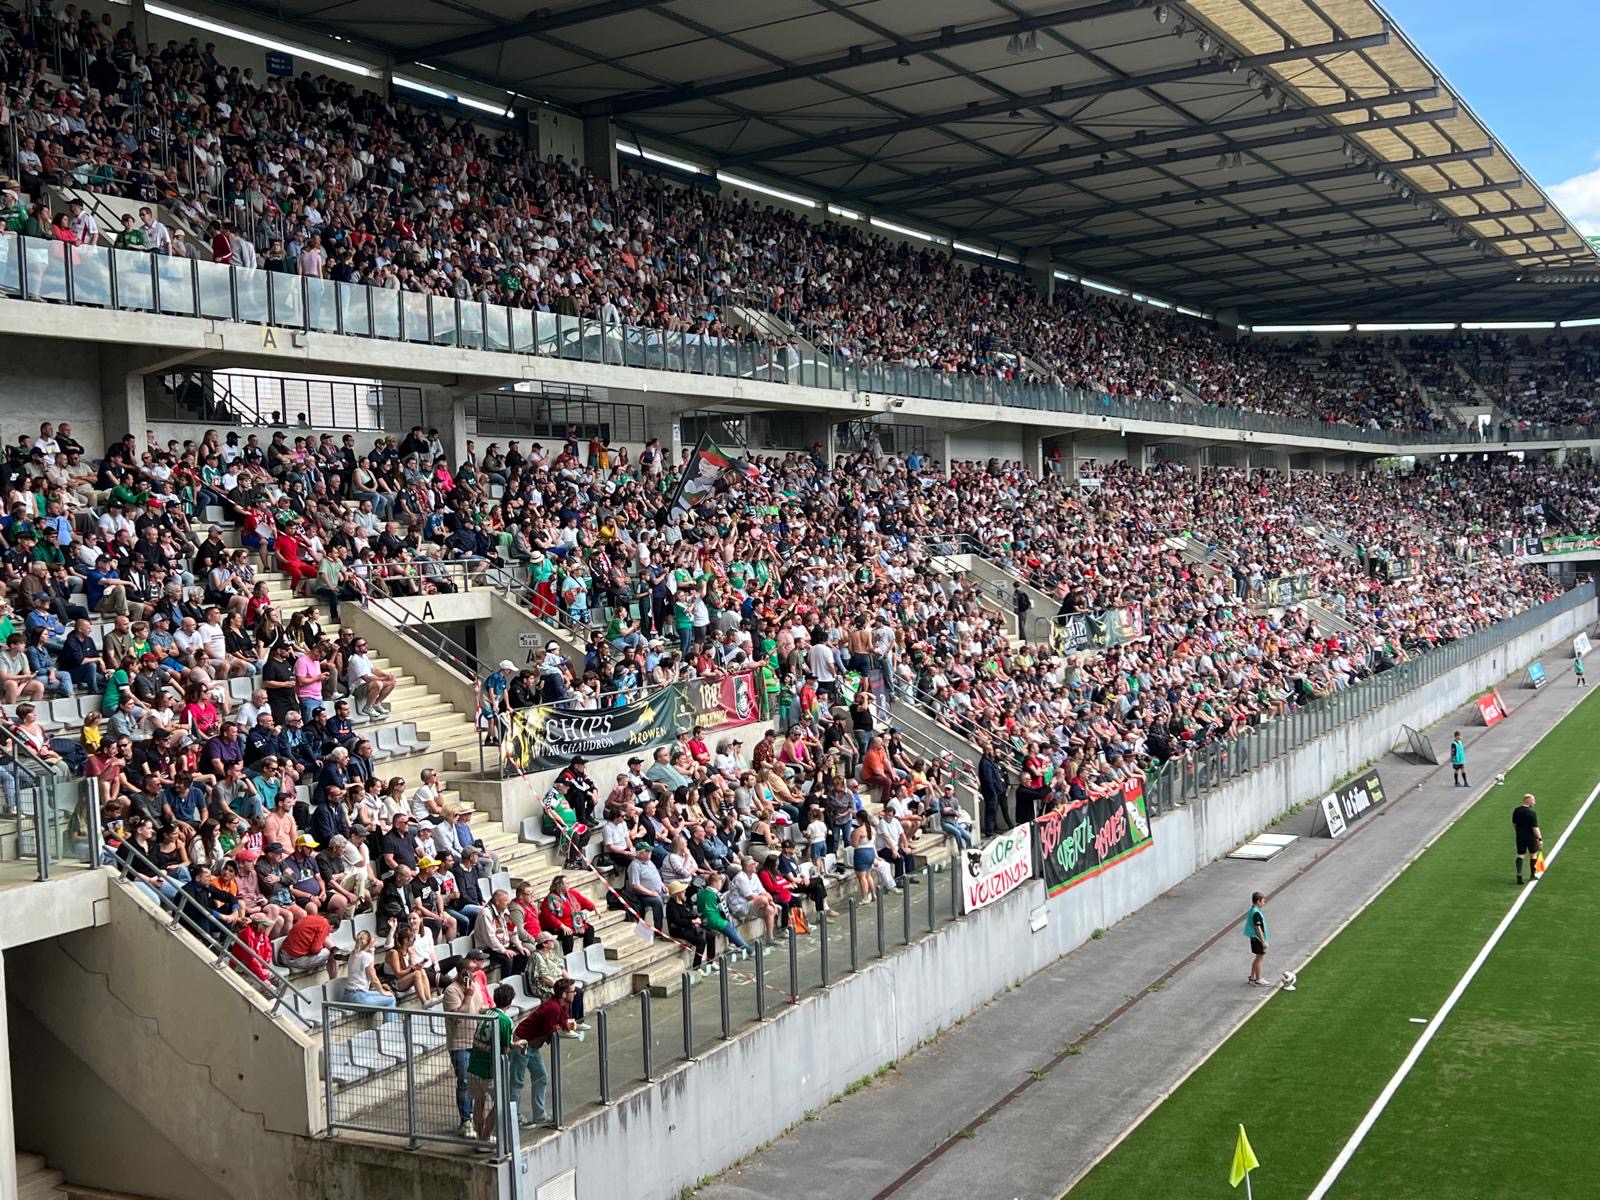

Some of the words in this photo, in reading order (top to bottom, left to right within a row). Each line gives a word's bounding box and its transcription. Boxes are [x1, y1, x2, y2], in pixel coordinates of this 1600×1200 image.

[263, 328, 277, 349] A
[865, 394, 871, 407] B
[422, 600, 435, 621] A
[545, 714, 614, 743] CHIPS
[560, 736, 615, 754] CHAUDRON
